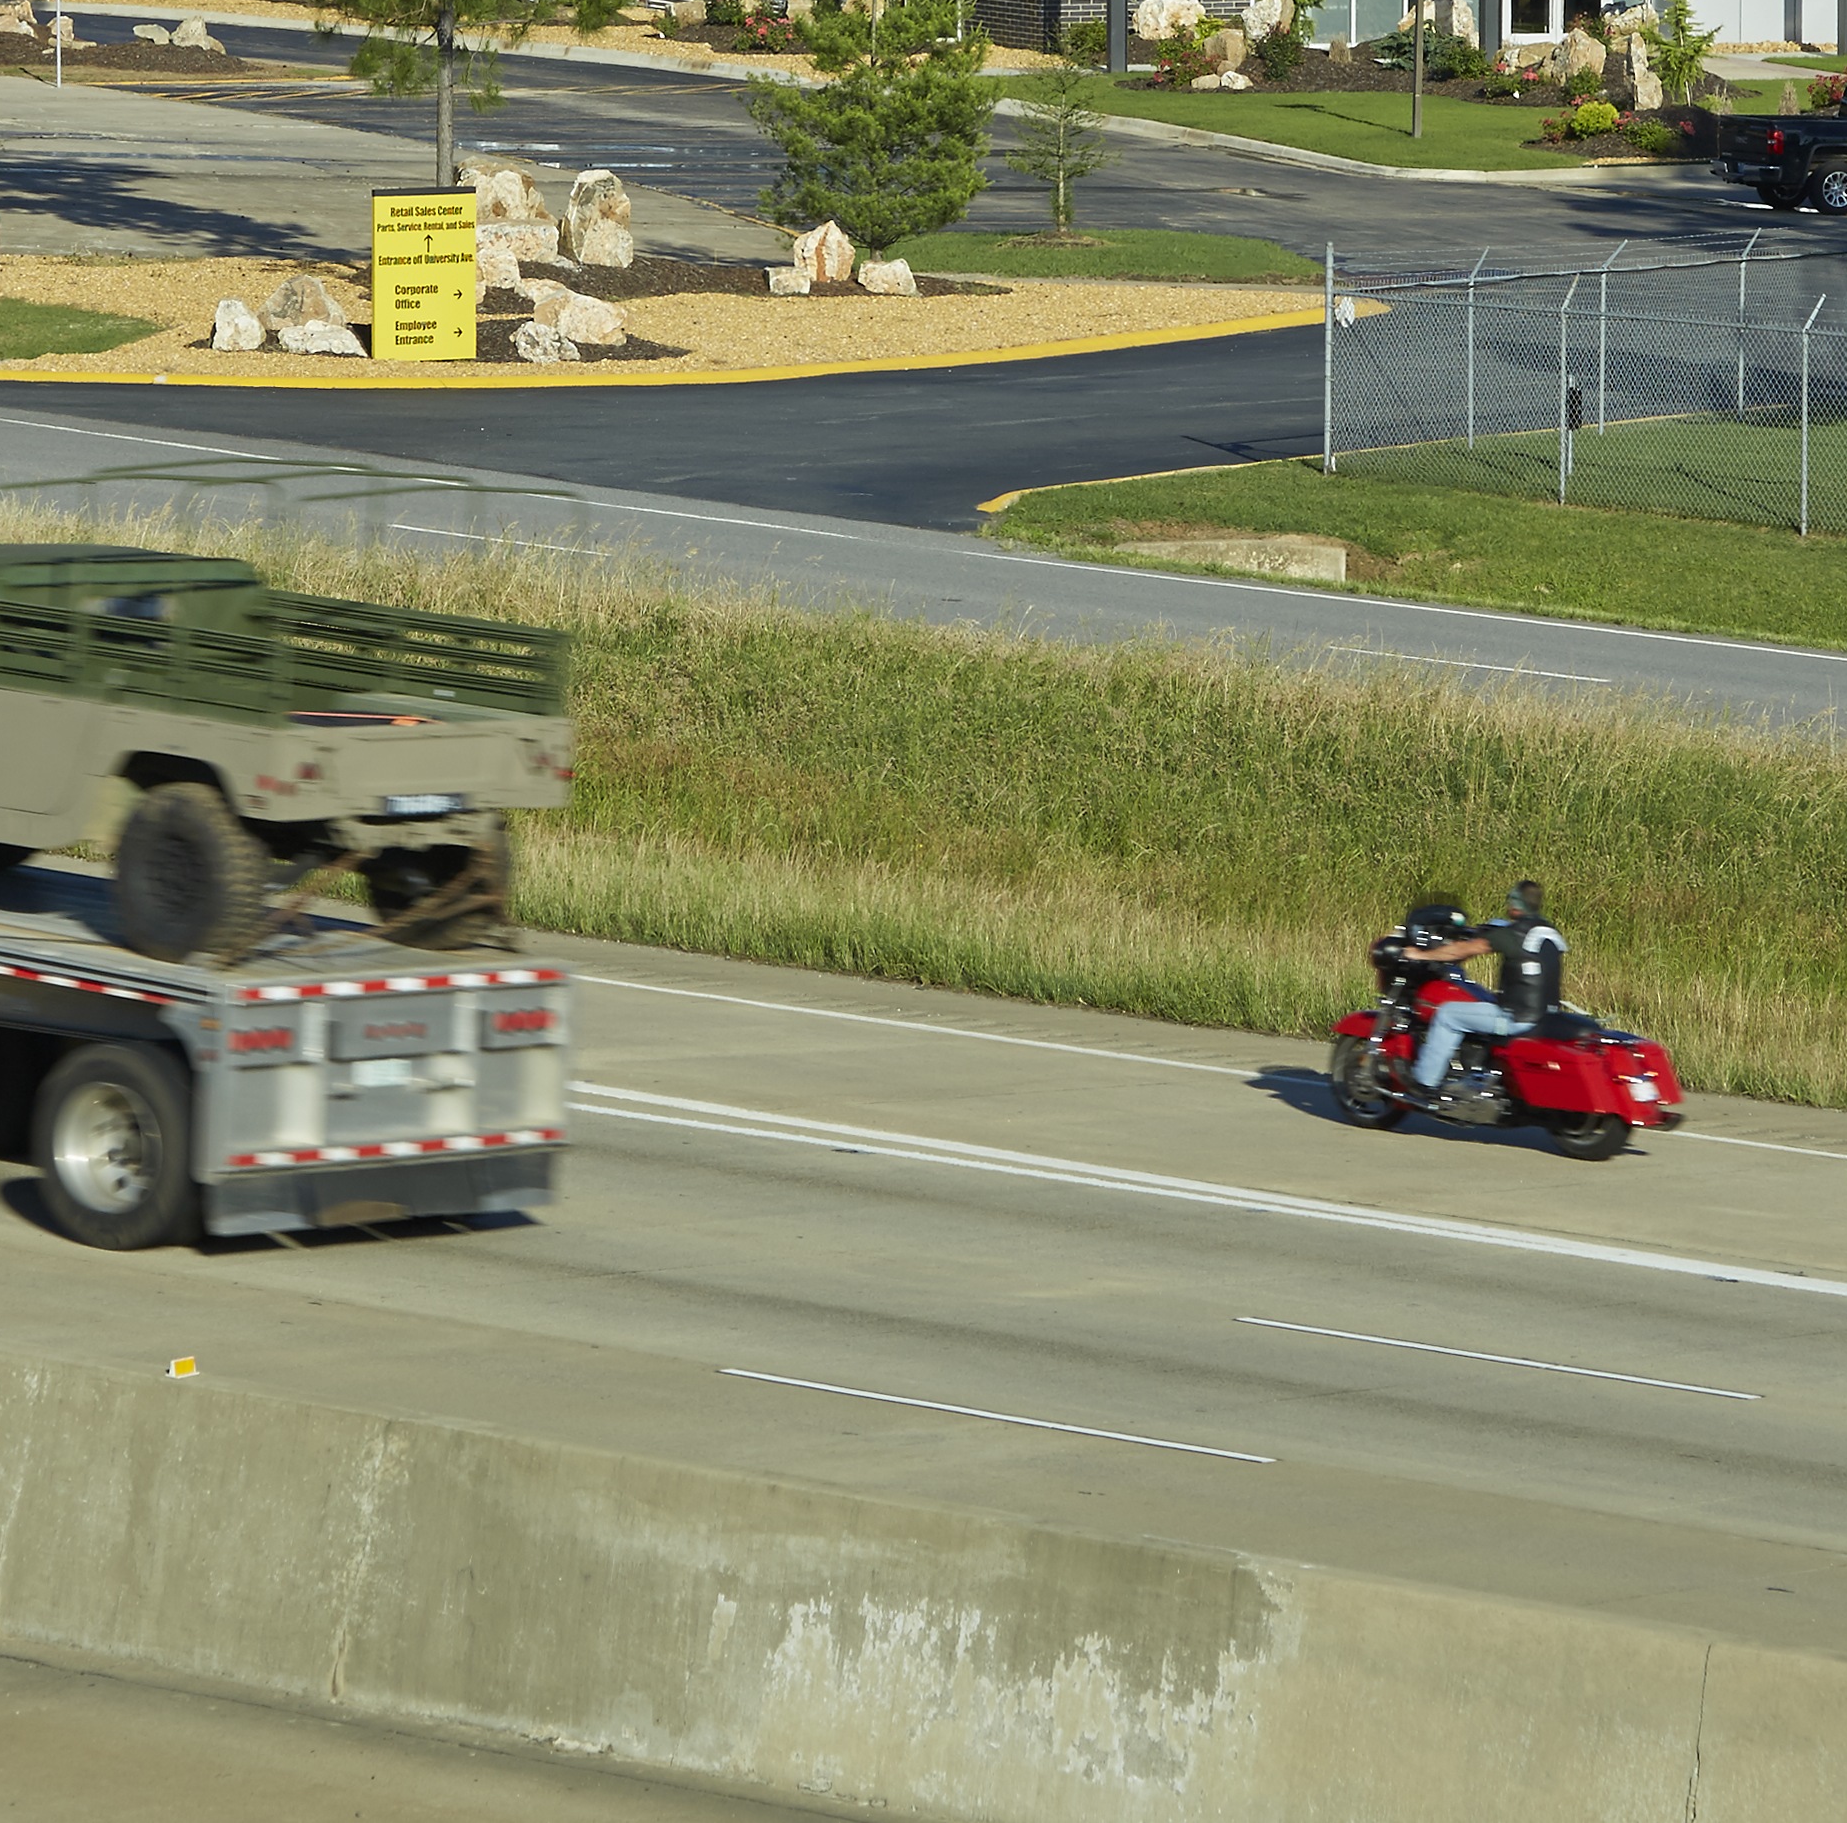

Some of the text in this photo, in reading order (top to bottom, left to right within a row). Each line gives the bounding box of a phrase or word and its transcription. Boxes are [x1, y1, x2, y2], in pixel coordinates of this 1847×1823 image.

[390, 205, 463, 217] Retail Sales Center
[445, 221, 457, 230] and
[458, 220, 475, 229] Sales
[378, 253, 474, 266] Entrance off University Ave.
[395, 284, 439, 296] Corporate
[395, 299, 421, 310] Office
[395, 321, 437, 331] Employee
[395, 335, 434, 345] Entrance
